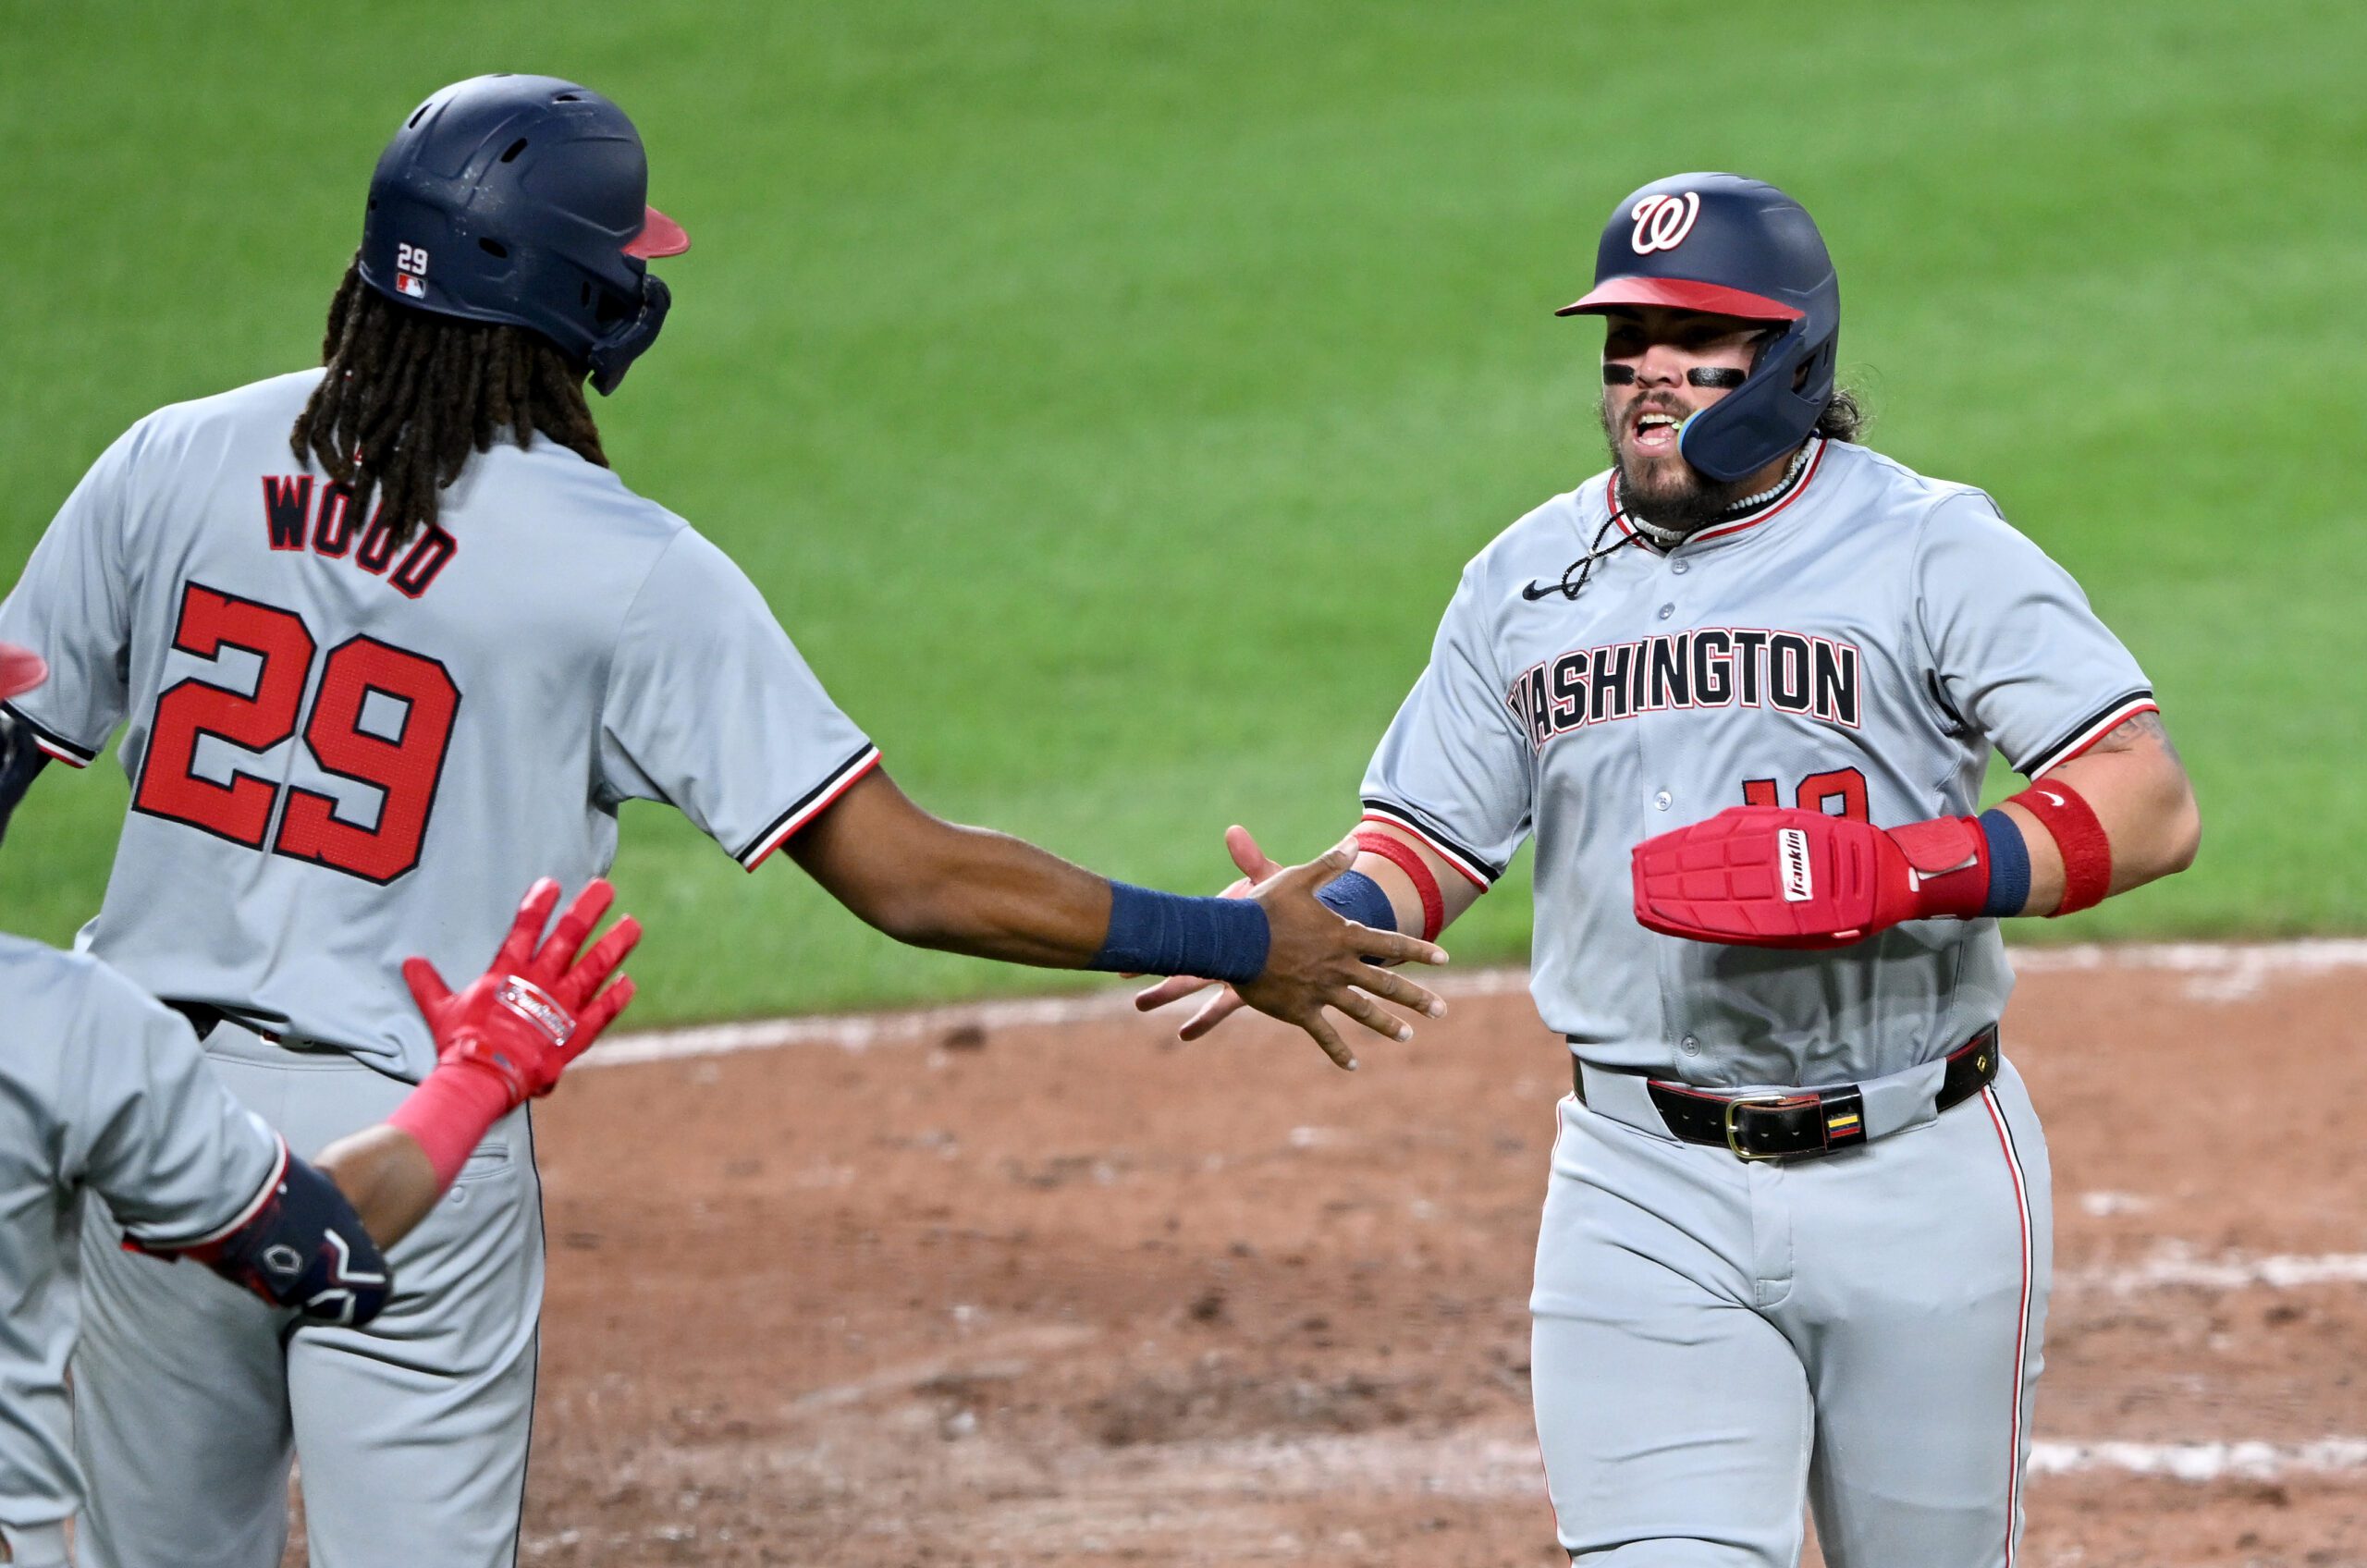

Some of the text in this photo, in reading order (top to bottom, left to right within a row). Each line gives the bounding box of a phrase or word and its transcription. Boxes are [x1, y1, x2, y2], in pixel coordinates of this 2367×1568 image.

[397, 242, 428, 276] 29
[1631, 190, 1701, 256] W
[262, 474, 459, 599] WOOD
[131, 580, 463, 887] 29
[1505, 627, 1861, 757] WASHINGTON
